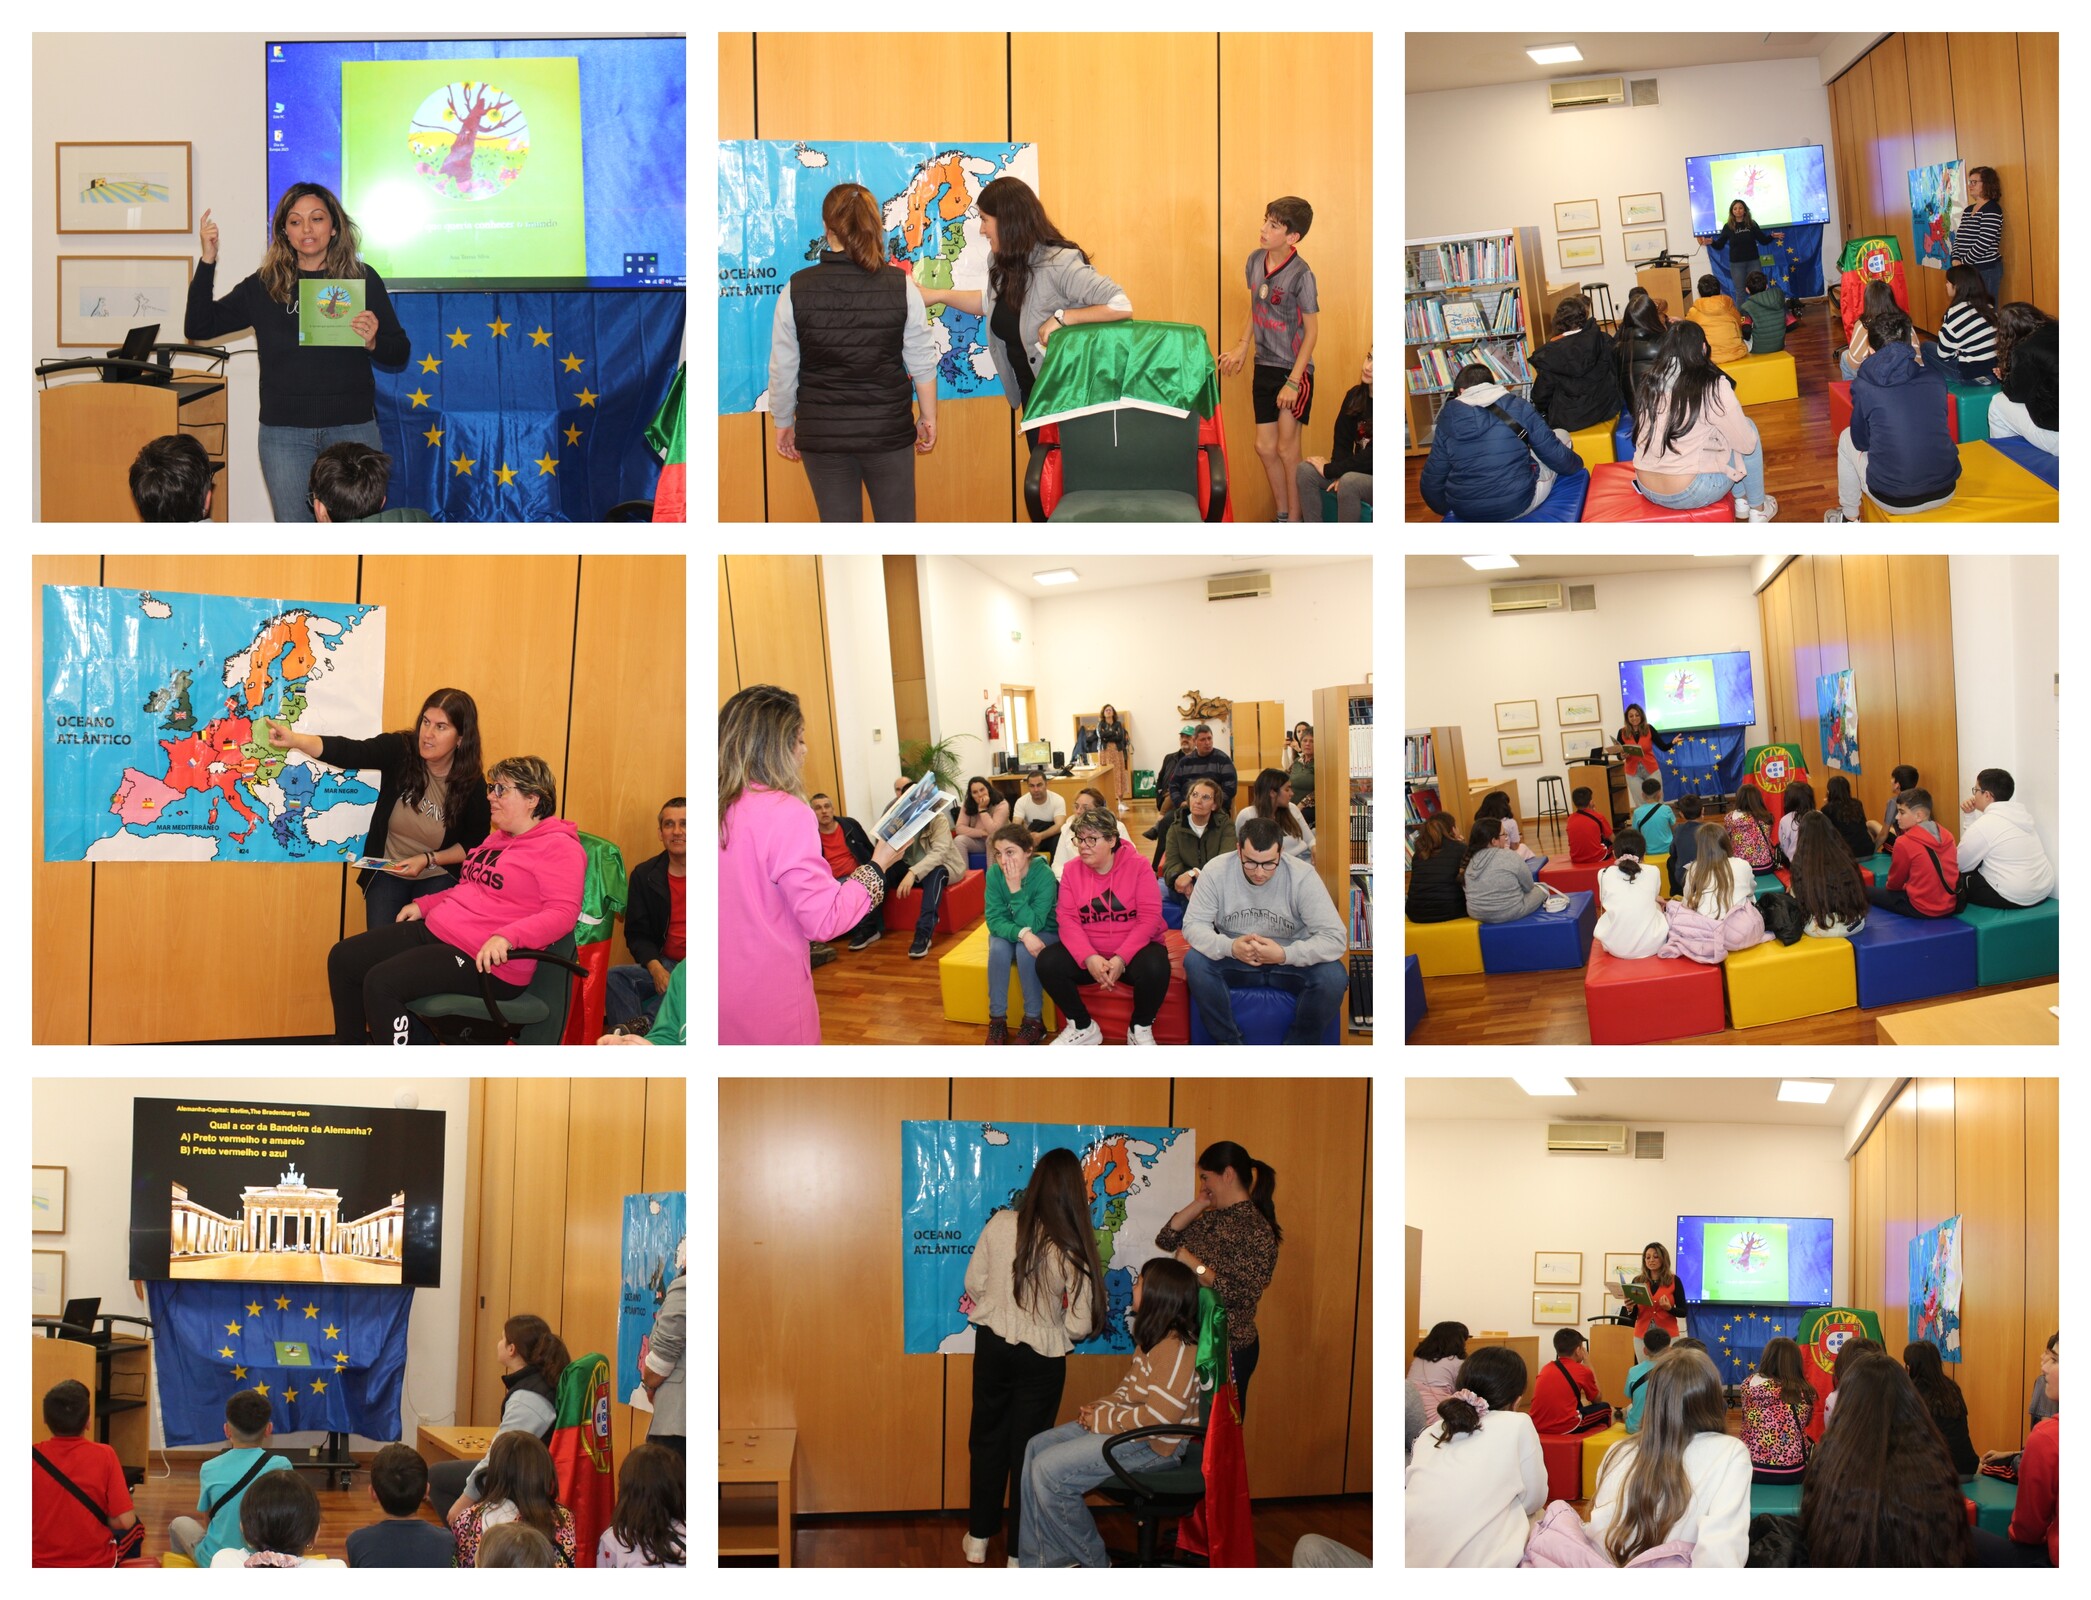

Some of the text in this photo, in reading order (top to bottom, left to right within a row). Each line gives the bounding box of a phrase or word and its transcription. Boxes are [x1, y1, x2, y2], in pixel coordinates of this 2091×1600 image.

[474, 219, 515, 230] conhecer
[525, 218, 558, 229] mundo
[718, 267, 777, 280] OCEANO
[719, 283, 785, 298] ATLÂNTIC
[57, 716, 115, 728] OCEANO
[56, 732, 132, 745] ATLÂNTICO
[461, 863, 505, 891] didas
[176, 1105, 230, 1114] Alemanha-Capital:
[209, 1121, 373, 1136] Qual a cor da Bandeira da Alemanha?
[180, 1132, 305, 1146] A) Preto vermelho e amarelo
[180, 1145, 191, 1156] B)
[192, 1146, 217, 1155] Preto
[218, 1148, 260, 1157] vermelho
[269, 1149, 288, 1158] azul
[913, 1230, 962, 1240] OCEANO
[913, 1243, 976, 1255] ATLÂNTICO
